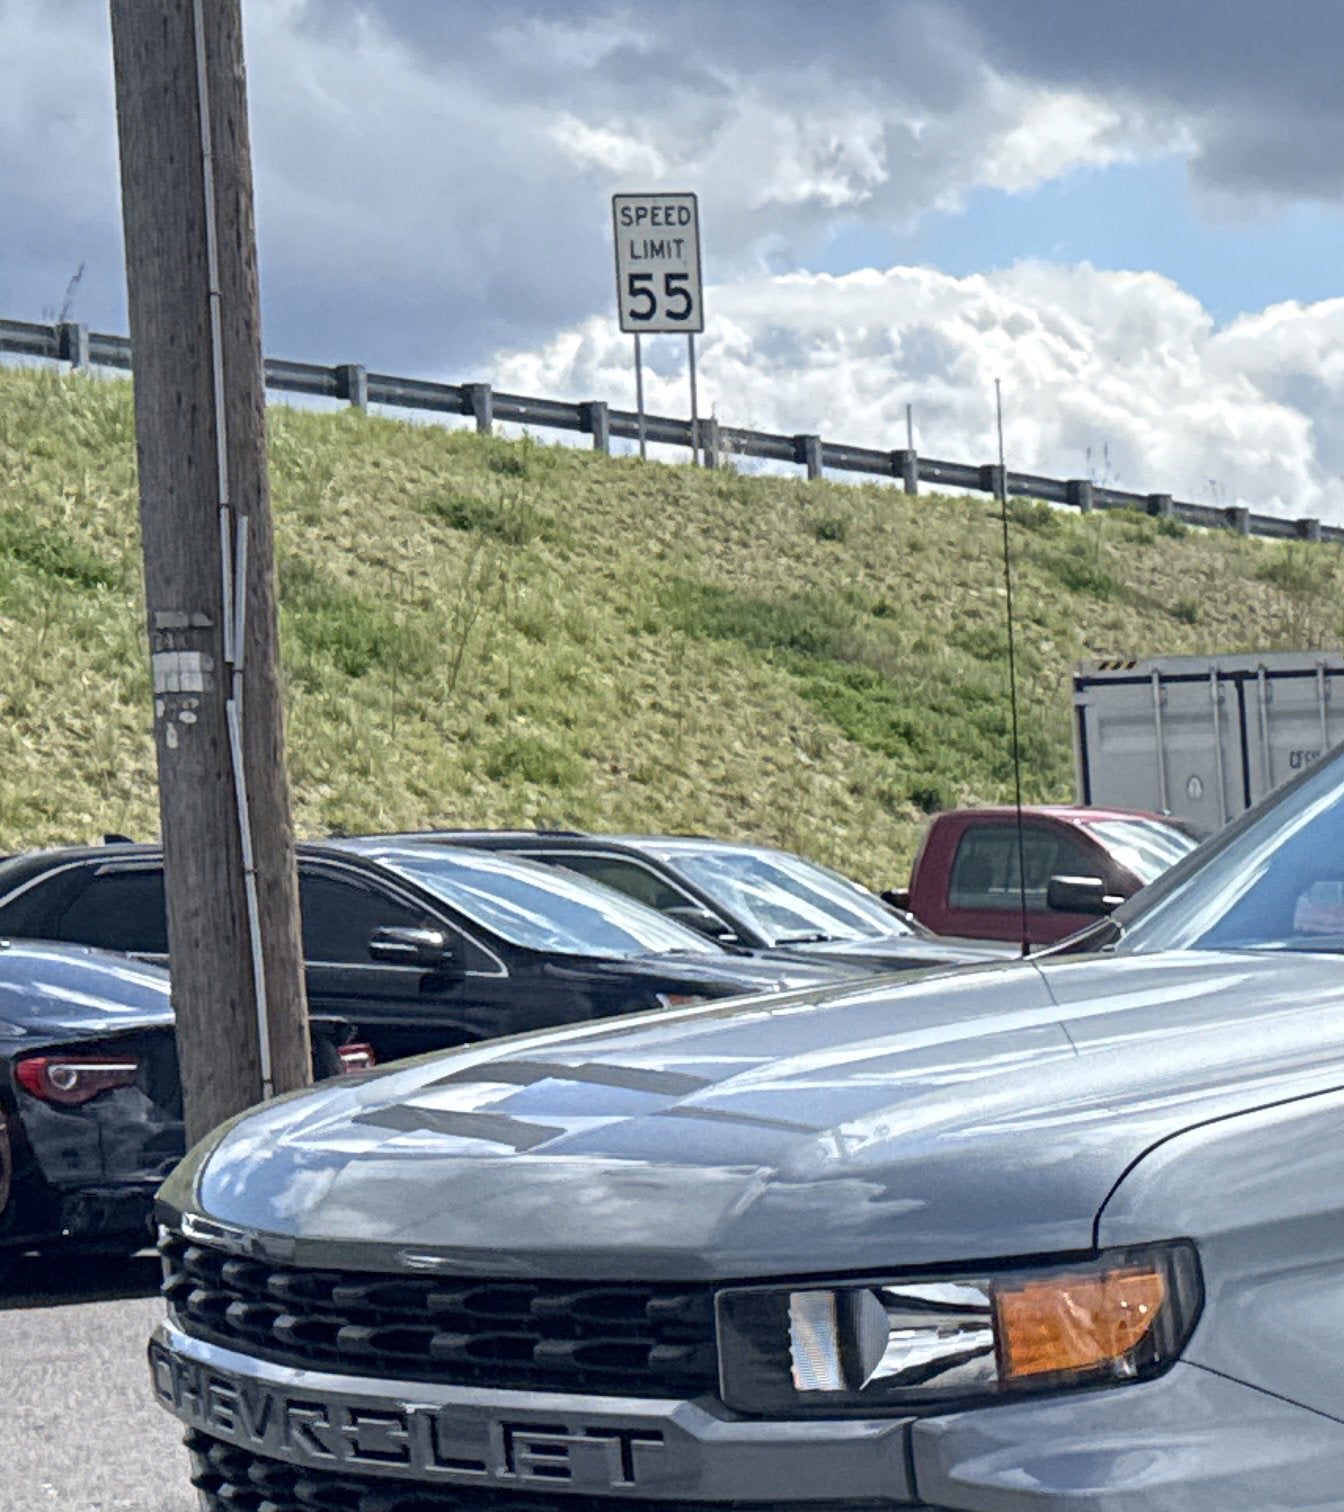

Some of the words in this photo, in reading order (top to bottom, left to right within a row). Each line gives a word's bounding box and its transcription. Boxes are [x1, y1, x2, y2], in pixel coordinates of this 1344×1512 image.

[620, 205, 691, 227] SPEED
[629, 238, 684, 260] LIMIT
[627, 272, 693, 321] 55
[151, 1346, 665, 1489] CHEVROLET
